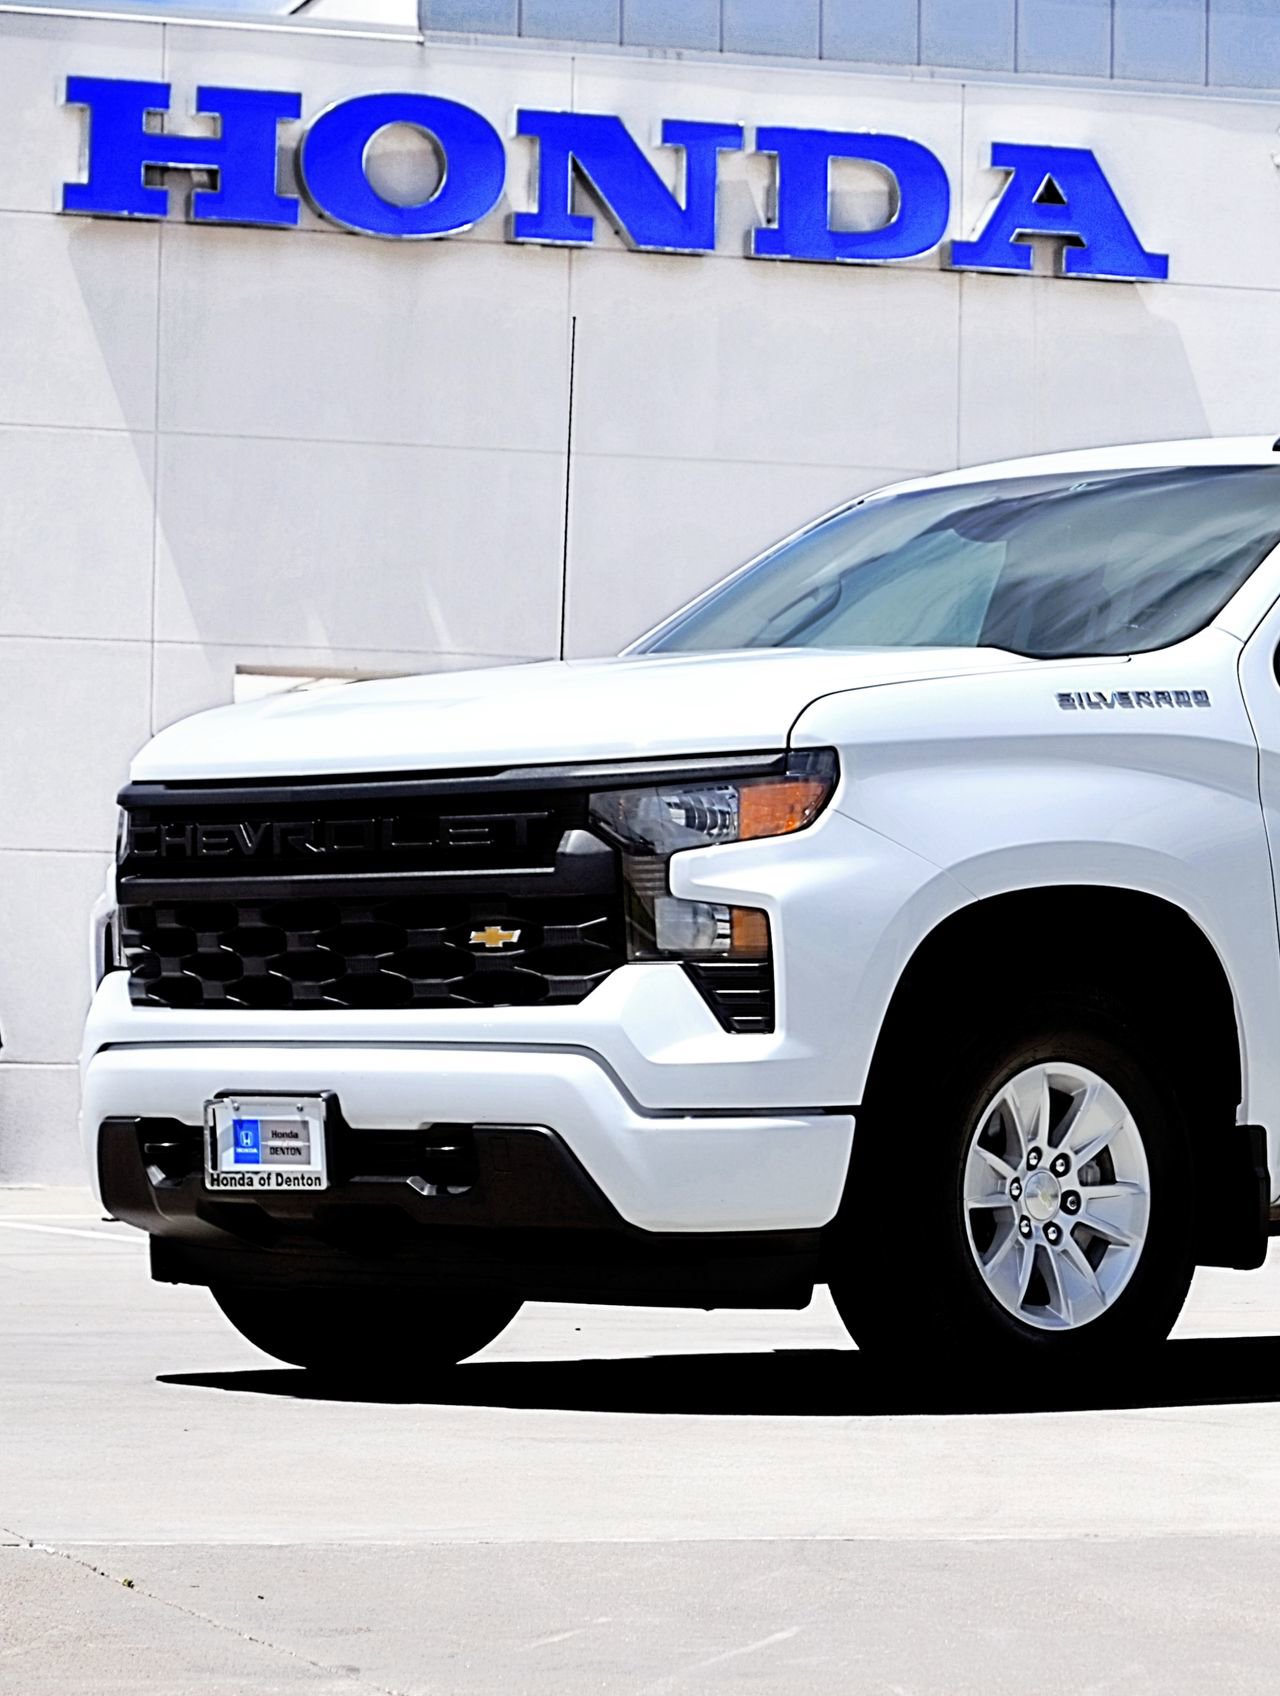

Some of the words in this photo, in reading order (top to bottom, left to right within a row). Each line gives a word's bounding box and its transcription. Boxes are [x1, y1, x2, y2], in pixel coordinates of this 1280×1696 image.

[61, 75, 1170, 282] HONDA
[1056, 690, 1211, 710] SILVERADO
[128, 811, 554, 857] CHEVROLET
[271, 1130, 299, 1139] Honda
[269, 1146, 302, 1156] DENTON
[210, 1173, 254, 1187] Honda
[258, 1173, 271, 1187] of
[275, 1173, 322, 1187] Denton
